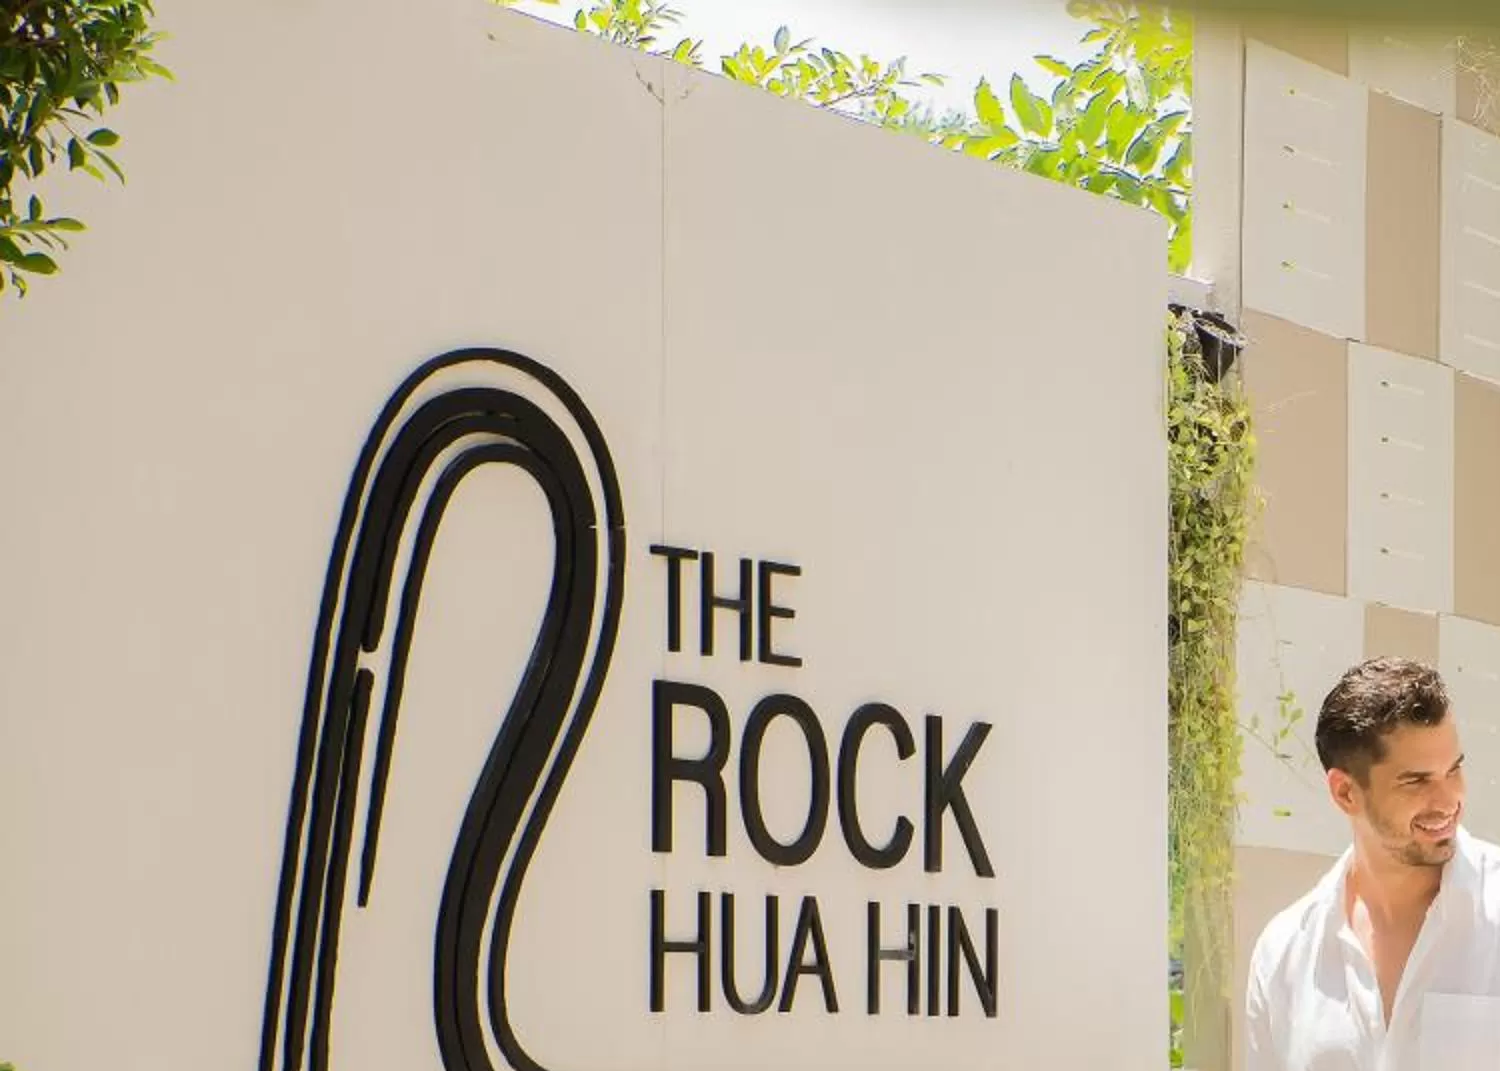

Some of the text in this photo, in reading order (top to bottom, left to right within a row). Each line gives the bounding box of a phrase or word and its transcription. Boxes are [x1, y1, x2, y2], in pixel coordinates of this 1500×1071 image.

[649, 544, 803, 668] THE
[651, 679, 996, 879] ROCK
[649, 889, 999, 1018] HUA HIN
